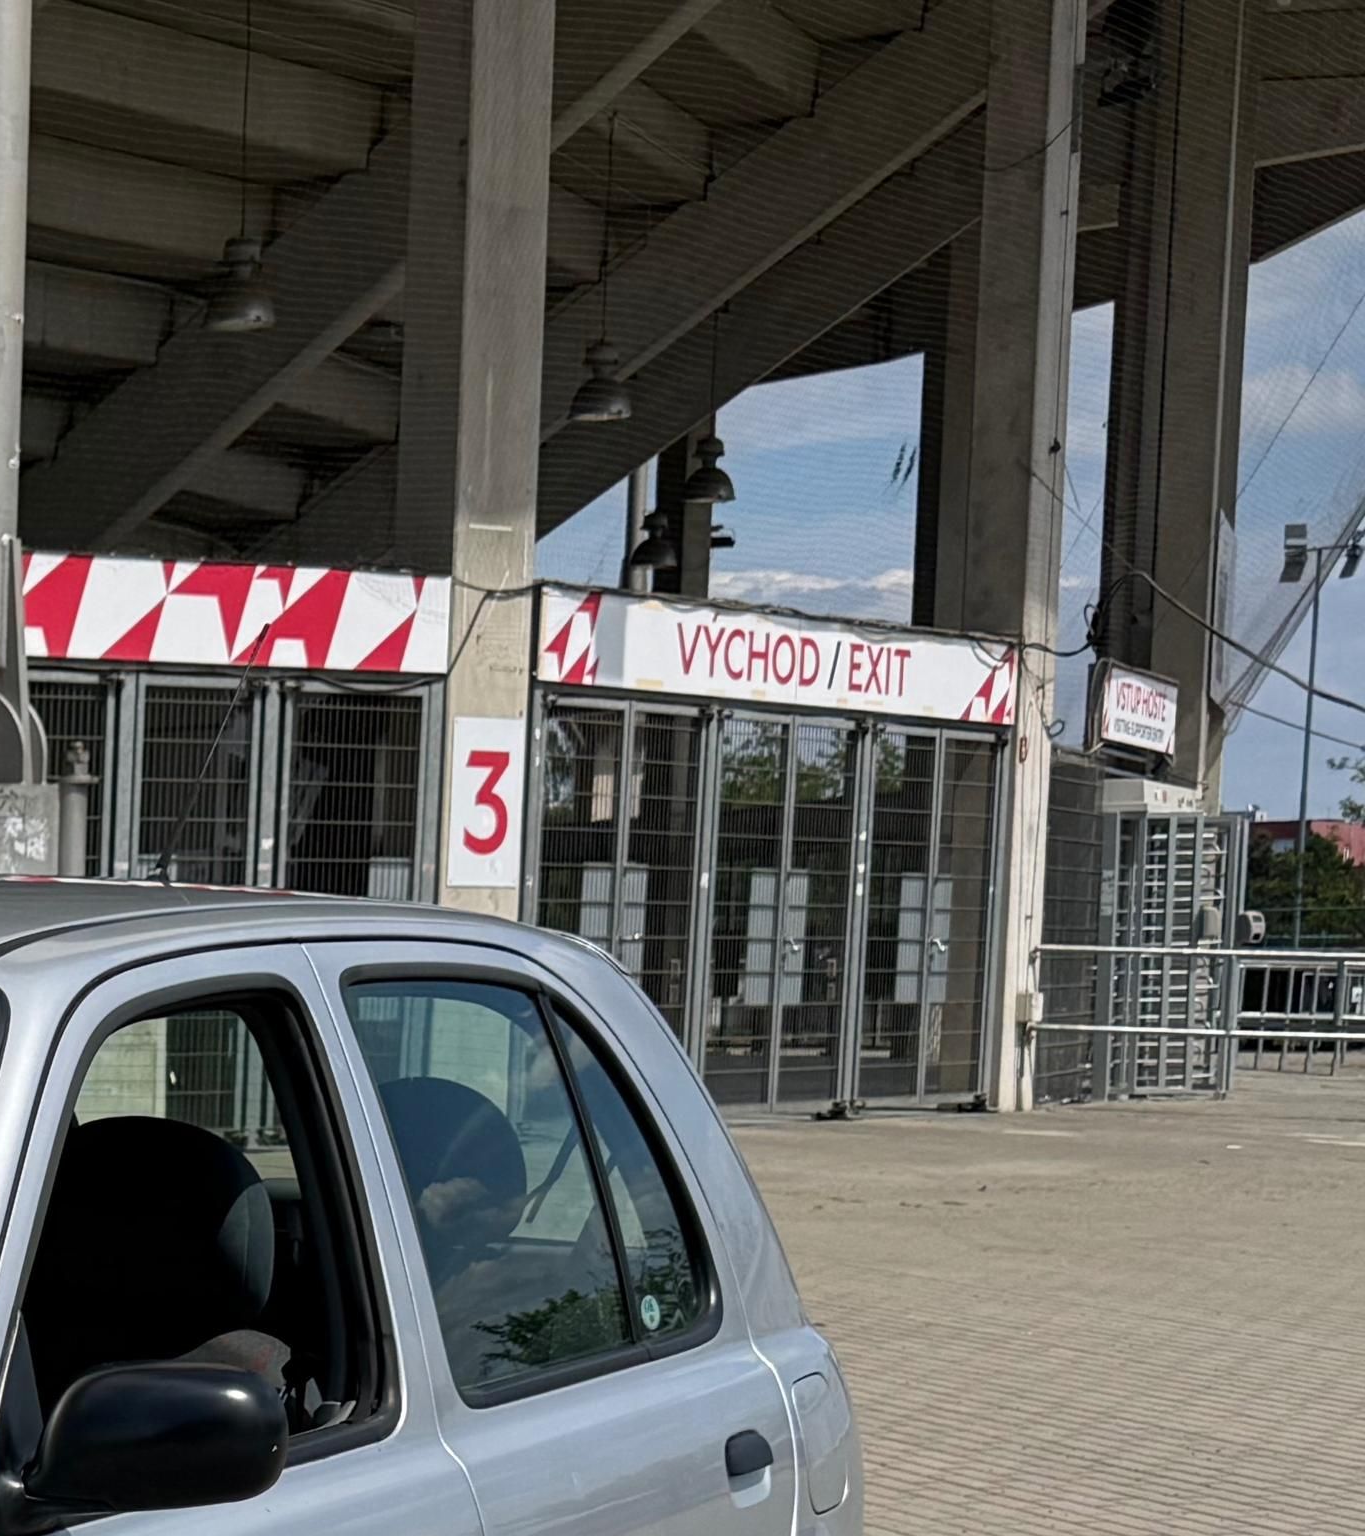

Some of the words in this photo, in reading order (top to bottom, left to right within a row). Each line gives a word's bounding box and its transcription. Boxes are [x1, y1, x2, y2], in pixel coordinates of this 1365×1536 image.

[827, 640, 841, 690] /
[847, 643, 911, 697] EXIT
[1115, 680, 1141, 714] VSTUP
[463, 750, 510, 856] 3
